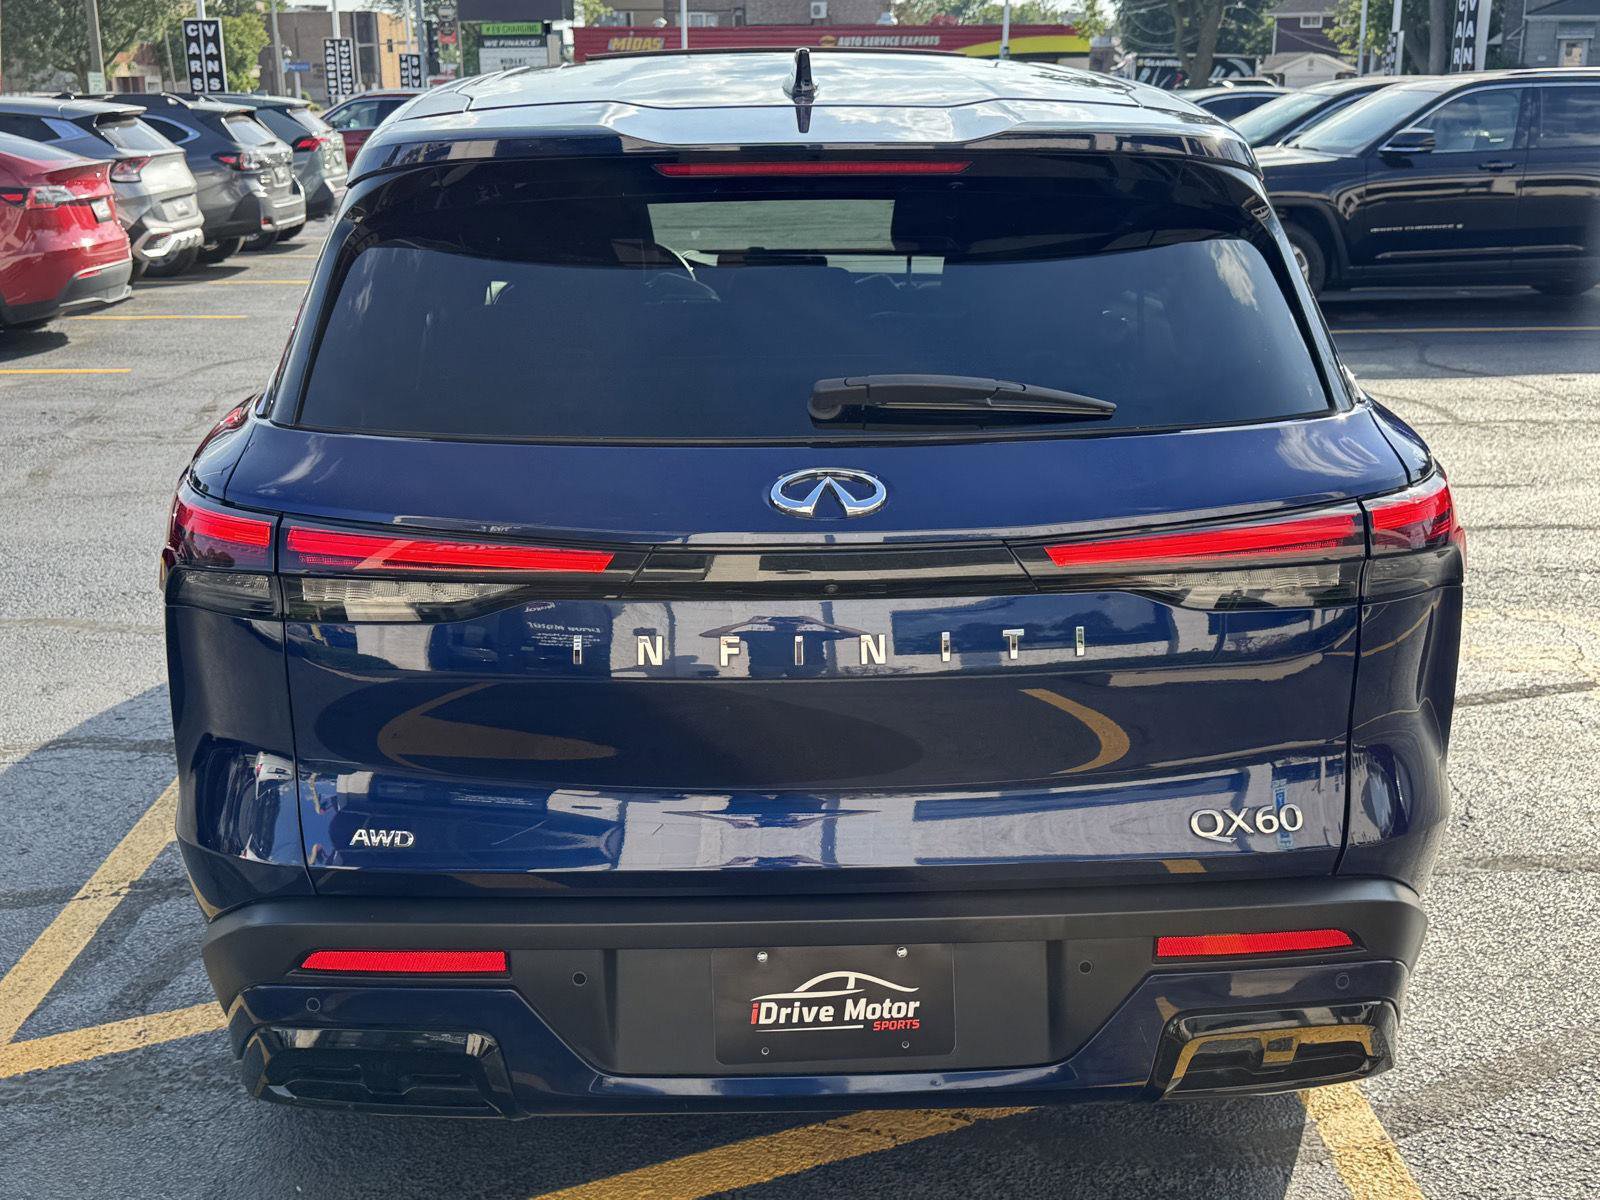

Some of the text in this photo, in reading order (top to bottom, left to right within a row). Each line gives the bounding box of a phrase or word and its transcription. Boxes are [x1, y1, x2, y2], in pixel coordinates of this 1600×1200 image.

[483, 39, 498, 47] WE
[837, 35, 862, 47] AUTO
[863, 35, 900, 46] SERVICE
[901, 35, 940, 46] EXPERTS
[186, 23, 203, 91] CARS
[203, 23, 221, 91] VANS
[572, 625, 1085, 667] INFINITI
[1190, 803, 1304, 843] QX60
[349, 828, 416, 848] AWD
[750, 997, 921, 1025] iDrive Motor
[872, 1019, 921, 1031] SPORTS
